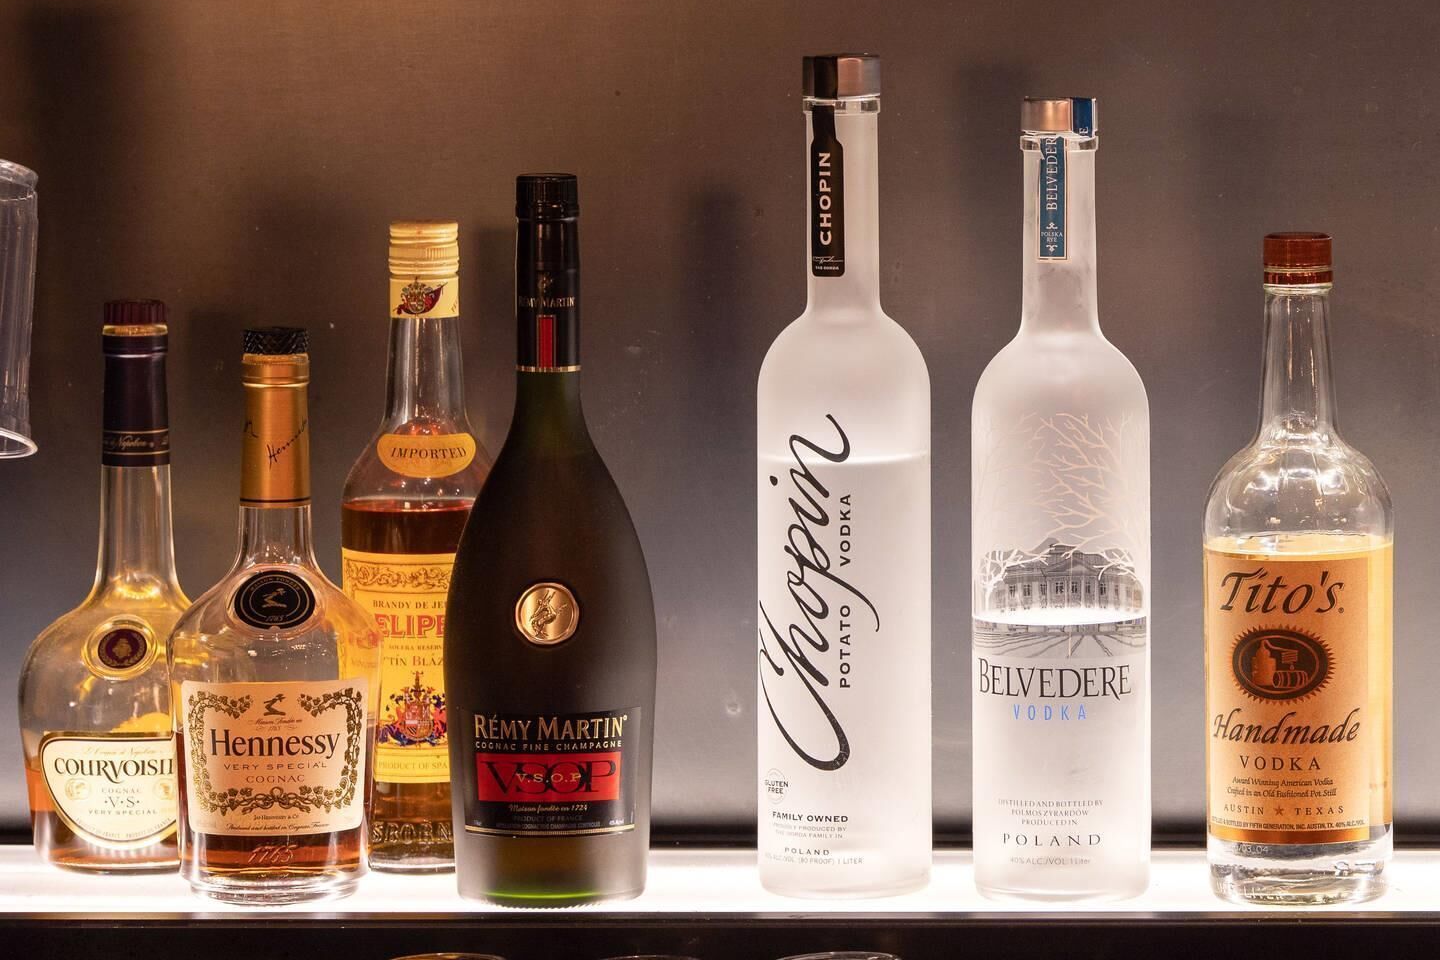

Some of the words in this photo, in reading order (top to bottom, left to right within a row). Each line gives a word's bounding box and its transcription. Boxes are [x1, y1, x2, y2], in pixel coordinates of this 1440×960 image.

[818, 152, 832, 246] CHOPIN
[390, 445, 467, 460] IMPORTED
[839, 493, 851, 567] VODKA
[759, 414, 880, 772] Chopin
[1220, 567, 1345, 614] Tito's
[372, 599, 412, 609] BRANDY
[415, 599, 430, 609] DE
[839, 604, 851, 689] POTATO
[978, 657, 1132, 701] BELVEDERE
[1013, 703, 1088, 721] VODKA
[474, 713, 533, 741] RÉMY
[538, 715, 624, 741] MARTIN
[1213, 707, 1361, 746] Handmade
[210, 728, 340, 760] Hennessy
[475, 740, 517, 751] COGNAC
[523, 741, 550, 751] FINE
[556, 740, 622, 751] CHAMPAGNE
[224, 762, 261, 771] VERY
[266, 761, 327, 770] SPECIAL
[1239, 754, 1321, 771] VODKA
[246, 773, 305, 784] COGNAC
[772, 811, 804, 821] FAMILY
[806, 814, 849, 823] OWNED
[1223, 803, 1264, 815] AUSTIN
[1295, 805, 1345, 816] TEXAS
[1002, 832, 1102, 847] POLAND
[784, 846, 830, 856] POLAND
